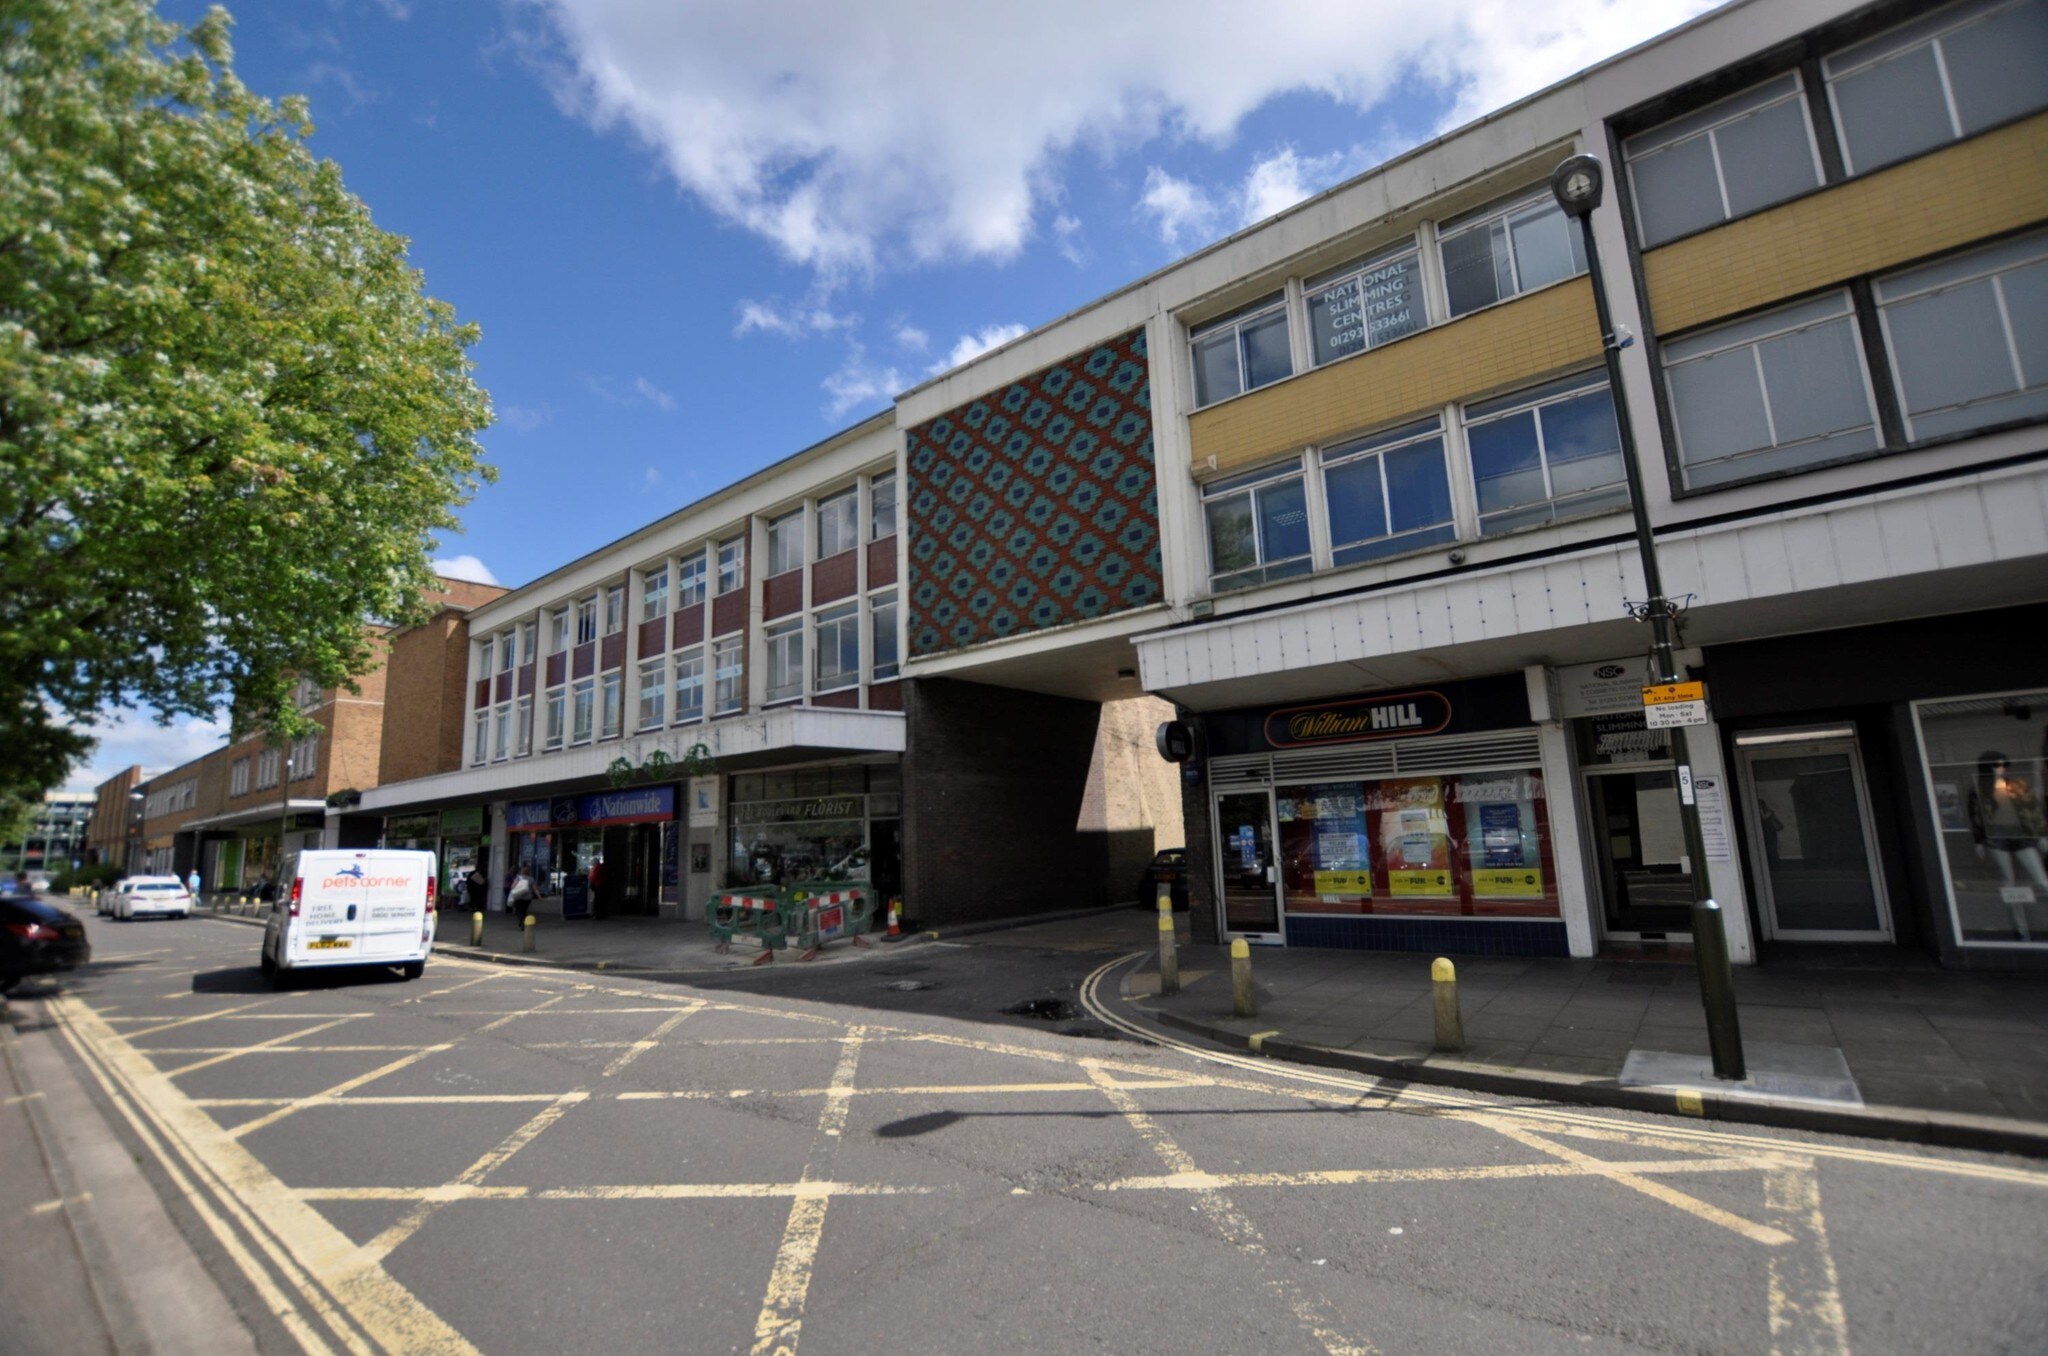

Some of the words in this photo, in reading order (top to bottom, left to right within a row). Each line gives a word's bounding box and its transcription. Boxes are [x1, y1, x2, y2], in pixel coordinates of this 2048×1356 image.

[1324, 264, 1408, 303] NATIONAL
[1329, 278, 1405, 316] SLIMMING
[1333, 294, 1403, 329] CENTRES
[1330, 325, 1365, 348] 01293
[1369, 309, 1411, 333] 533661
[1668, 703, 1694, 711] loading
[1680, 710, 1693, 718] Sat
[1290, 711, 1370, 740] William
[1371, 703, 1423, 730] HILL
[602, 792, 661, 818] Nationwide
[804, 800, 853, 816] FLORIST
[322, 876, 357, 890] pets
[360, 877, 412, 888] corner
[312, 904, 333, 912] FREE
[305, 918, 344, 926] DELIVERY
